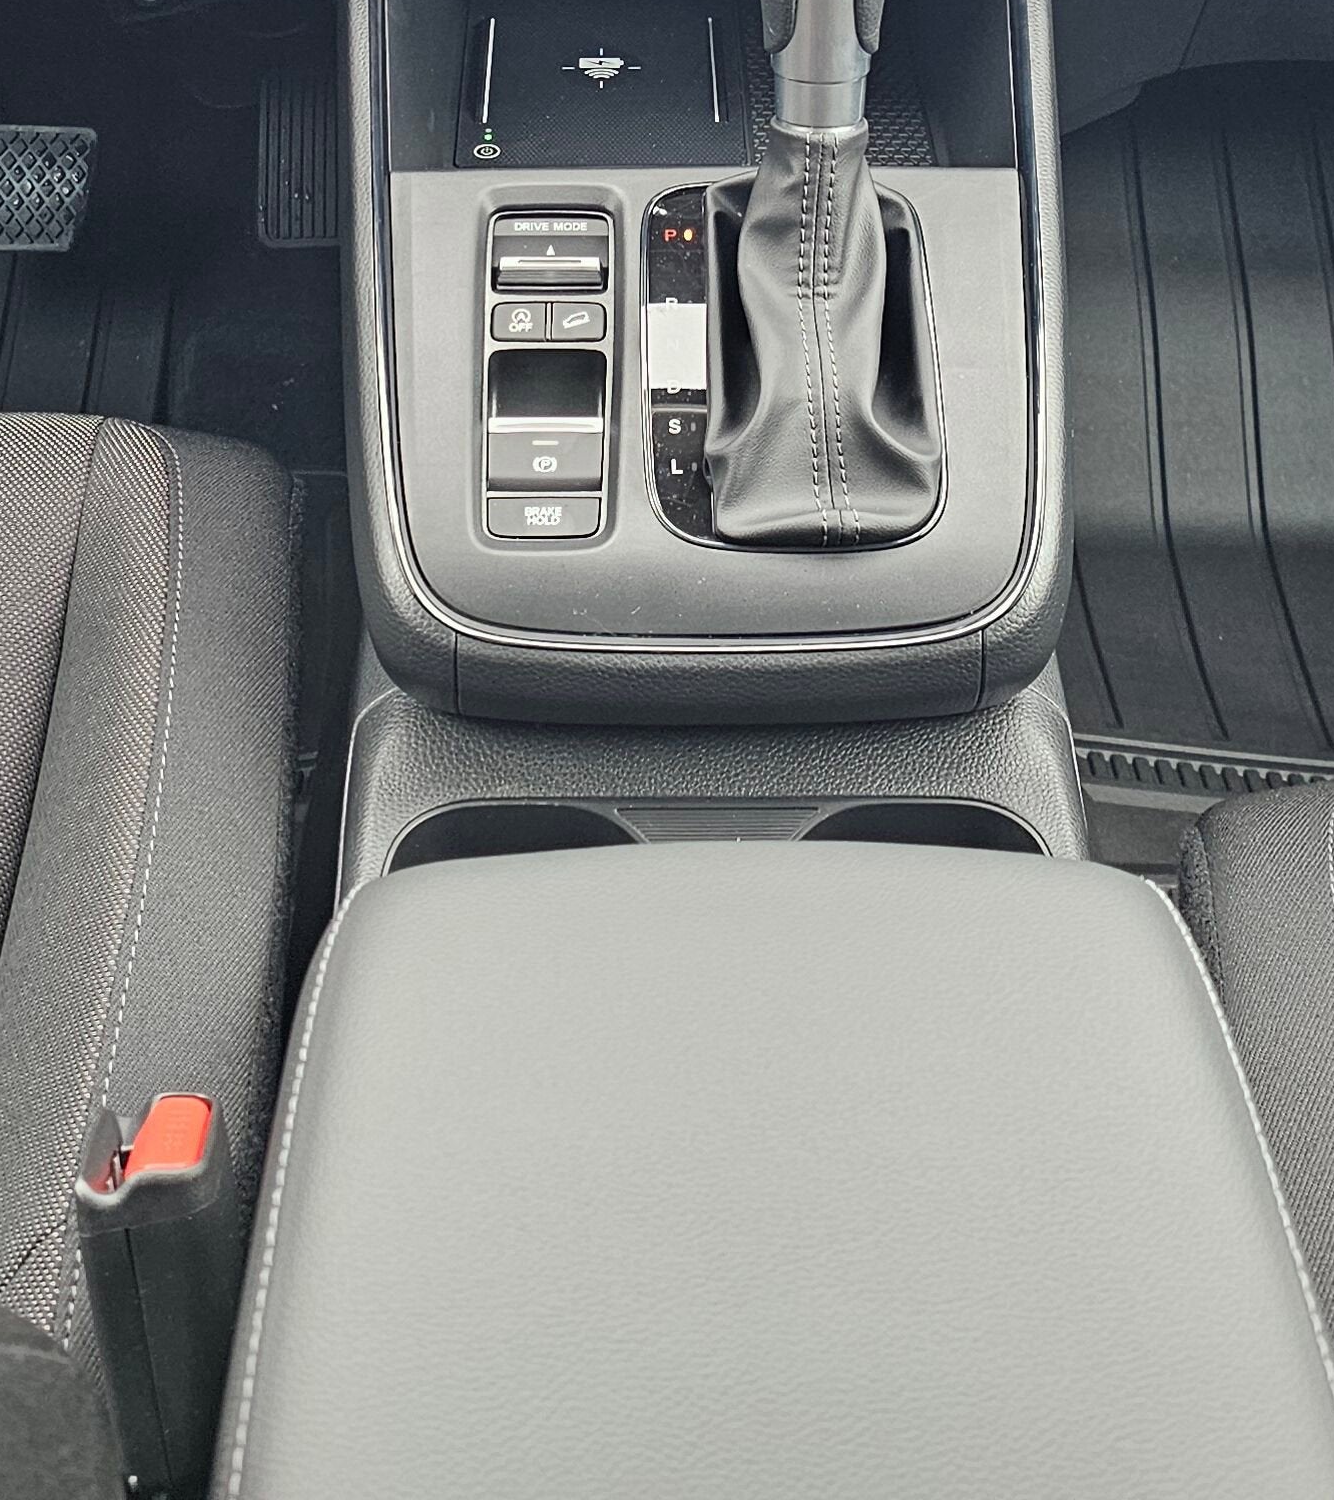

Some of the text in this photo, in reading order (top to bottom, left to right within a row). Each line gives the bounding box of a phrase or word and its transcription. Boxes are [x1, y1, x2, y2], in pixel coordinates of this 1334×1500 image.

[514, 222, 587, 231] DRIVE MODE
[664, 229, 677, 242] P
[508, 322, 533, 332] OFF
[668, 419, 682, 435] S
[670, 459, 683, 475] L
[524, 506, 562, 516] BRAKE
[527, 517, 560, 526] HOLD
